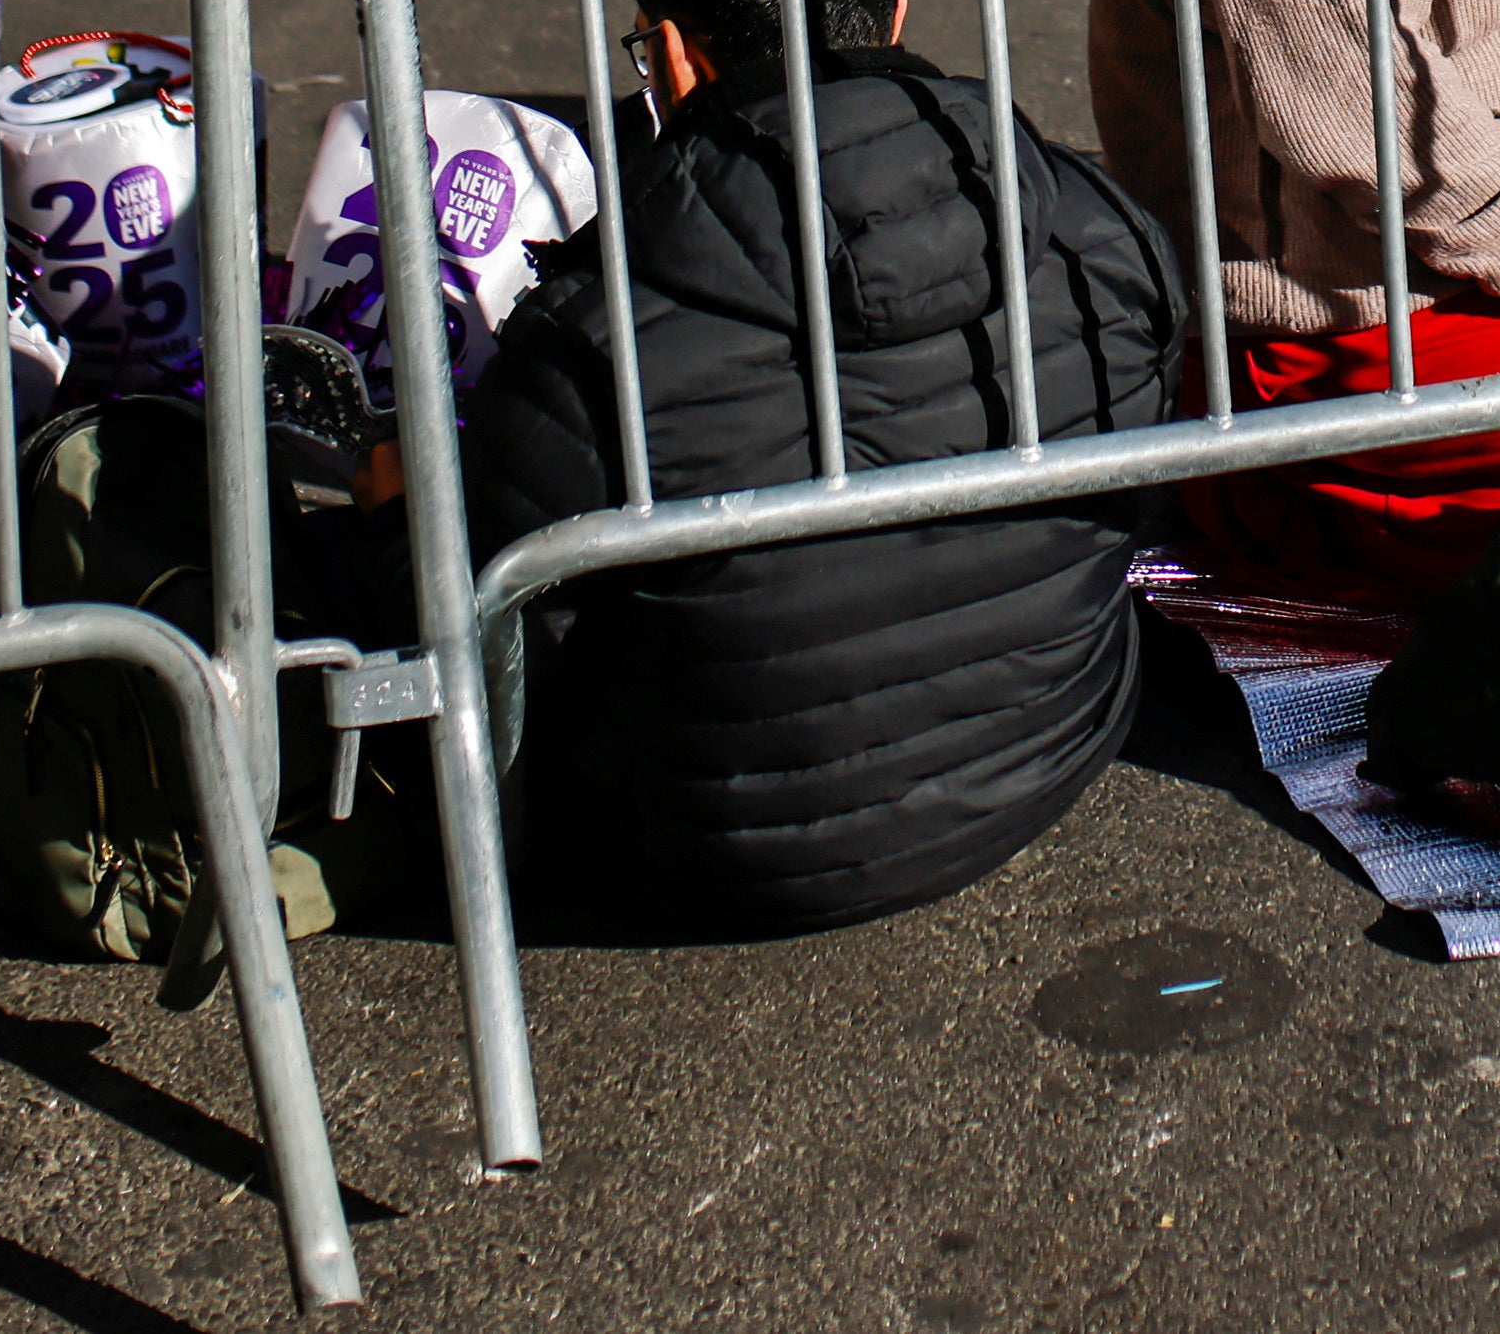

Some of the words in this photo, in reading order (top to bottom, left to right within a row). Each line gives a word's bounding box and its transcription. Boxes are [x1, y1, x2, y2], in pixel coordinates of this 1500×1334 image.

[112, 177, 159, 209] NEW
[452, 166, 507, 205] NEW
[32, 164, 170, 260] 20
[448, 190, 498, 222] YEAR'S
[119, 215, 165, 246] EVE
[440, 206, 493, 251] EVE
[50, 248, 186, 345] 25
